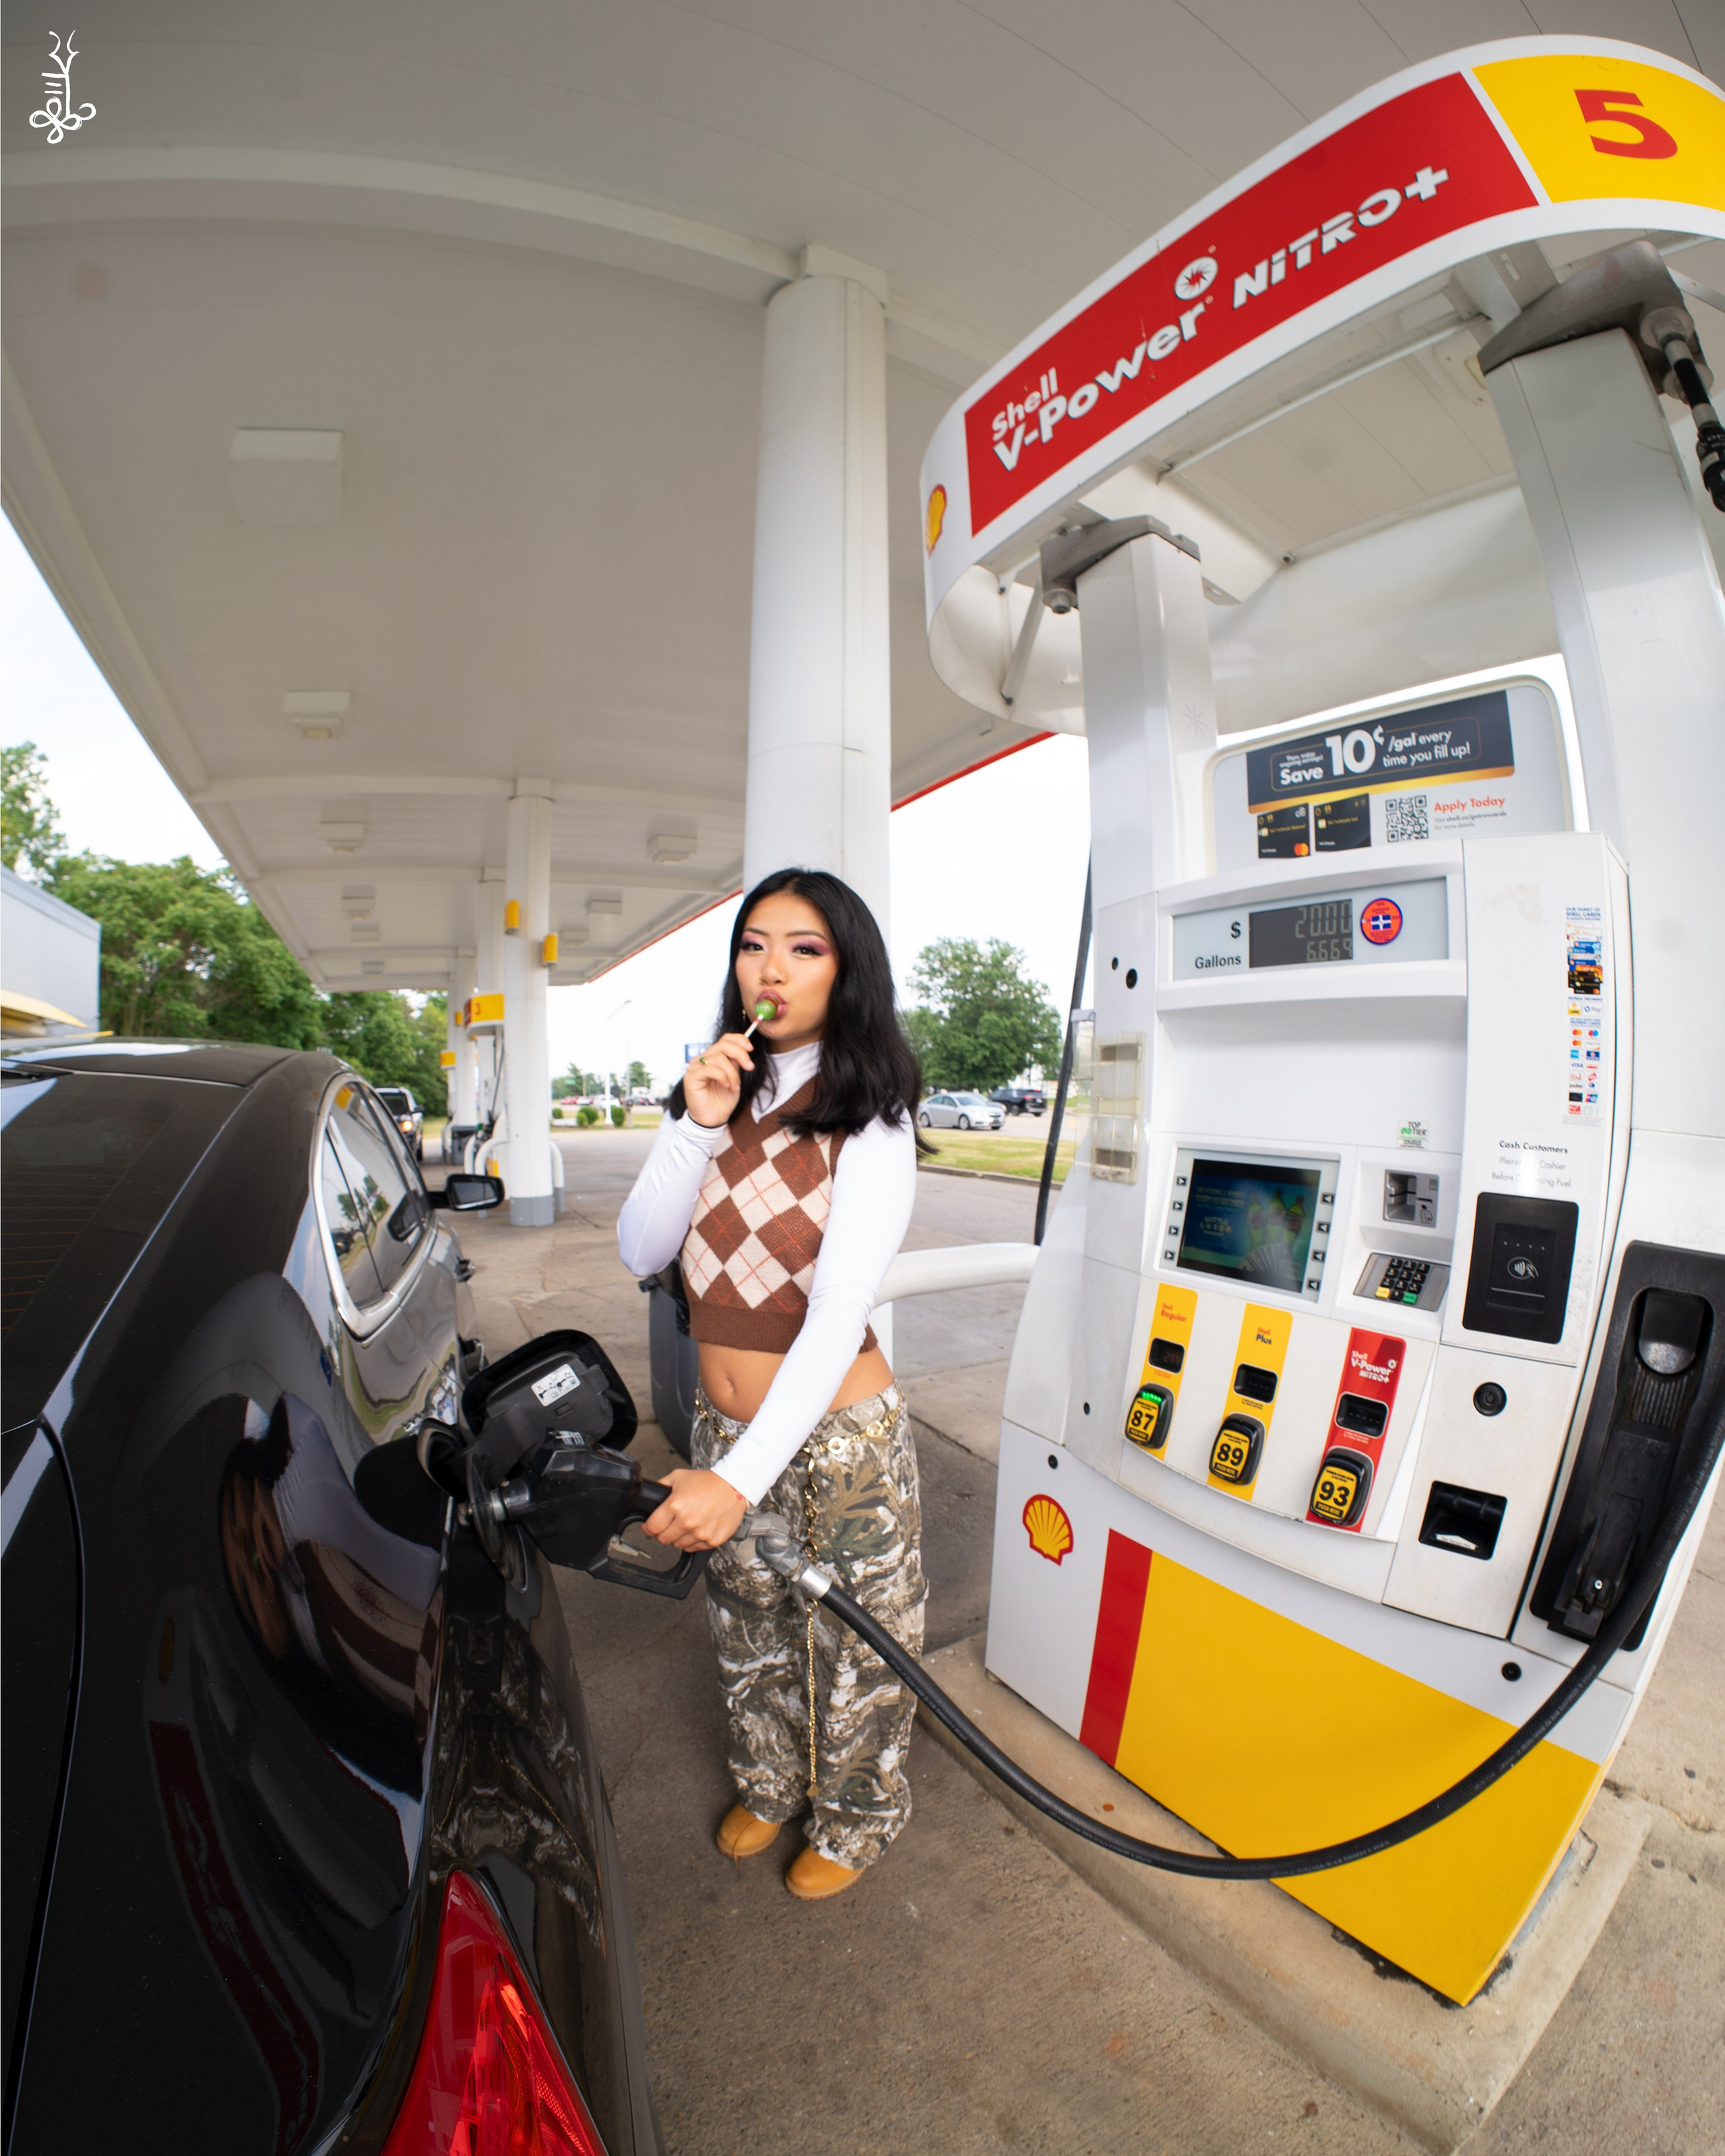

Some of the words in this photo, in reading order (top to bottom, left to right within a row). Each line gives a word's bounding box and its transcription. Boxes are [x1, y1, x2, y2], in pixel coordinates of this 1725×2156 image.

[1573, 89, 1679, 160] 5
[993, 300, 1208, 471] V-Power
[992, 367, 1059, 442] Shell
[1418, 730, 1452, 744] every
[1383, 754, 1408, 767] time
[1410, 751, 1433, 767] you
[1434, 744, 1448, 759] fill
[1450, 741, 1471, 759] up!
[1280, 766, 1324, 786] Save
[1434, 800, 1468, 814] Apply
[1469, 796, 1505, 808] Today
[1230, 920, 1242, 939] $
[1194, 955, 1242, 969] Gallons
[1499, 1140, 1520, 1149] Cash
[1523, 1142, 1569, 1154] Customers
[1539, 1160, 1567, 1170] Cashier
[1491, 1171, 1515, 1181] Before
[1557, 1178, 1572, 1188] Fuel
[1161, 1309, 1187, 1322] Regular
[1256, 1333, 1272, 1345] Plus
[1351, 1350, 1368, 1360] Shell
[1350, 1357, 1391, 1376] V-Power
[1131, 1410, 1154, 1430] 87
[1217, 1443, 1244, 1467] 89
[1319, 1481, 1350, 1507] 93
